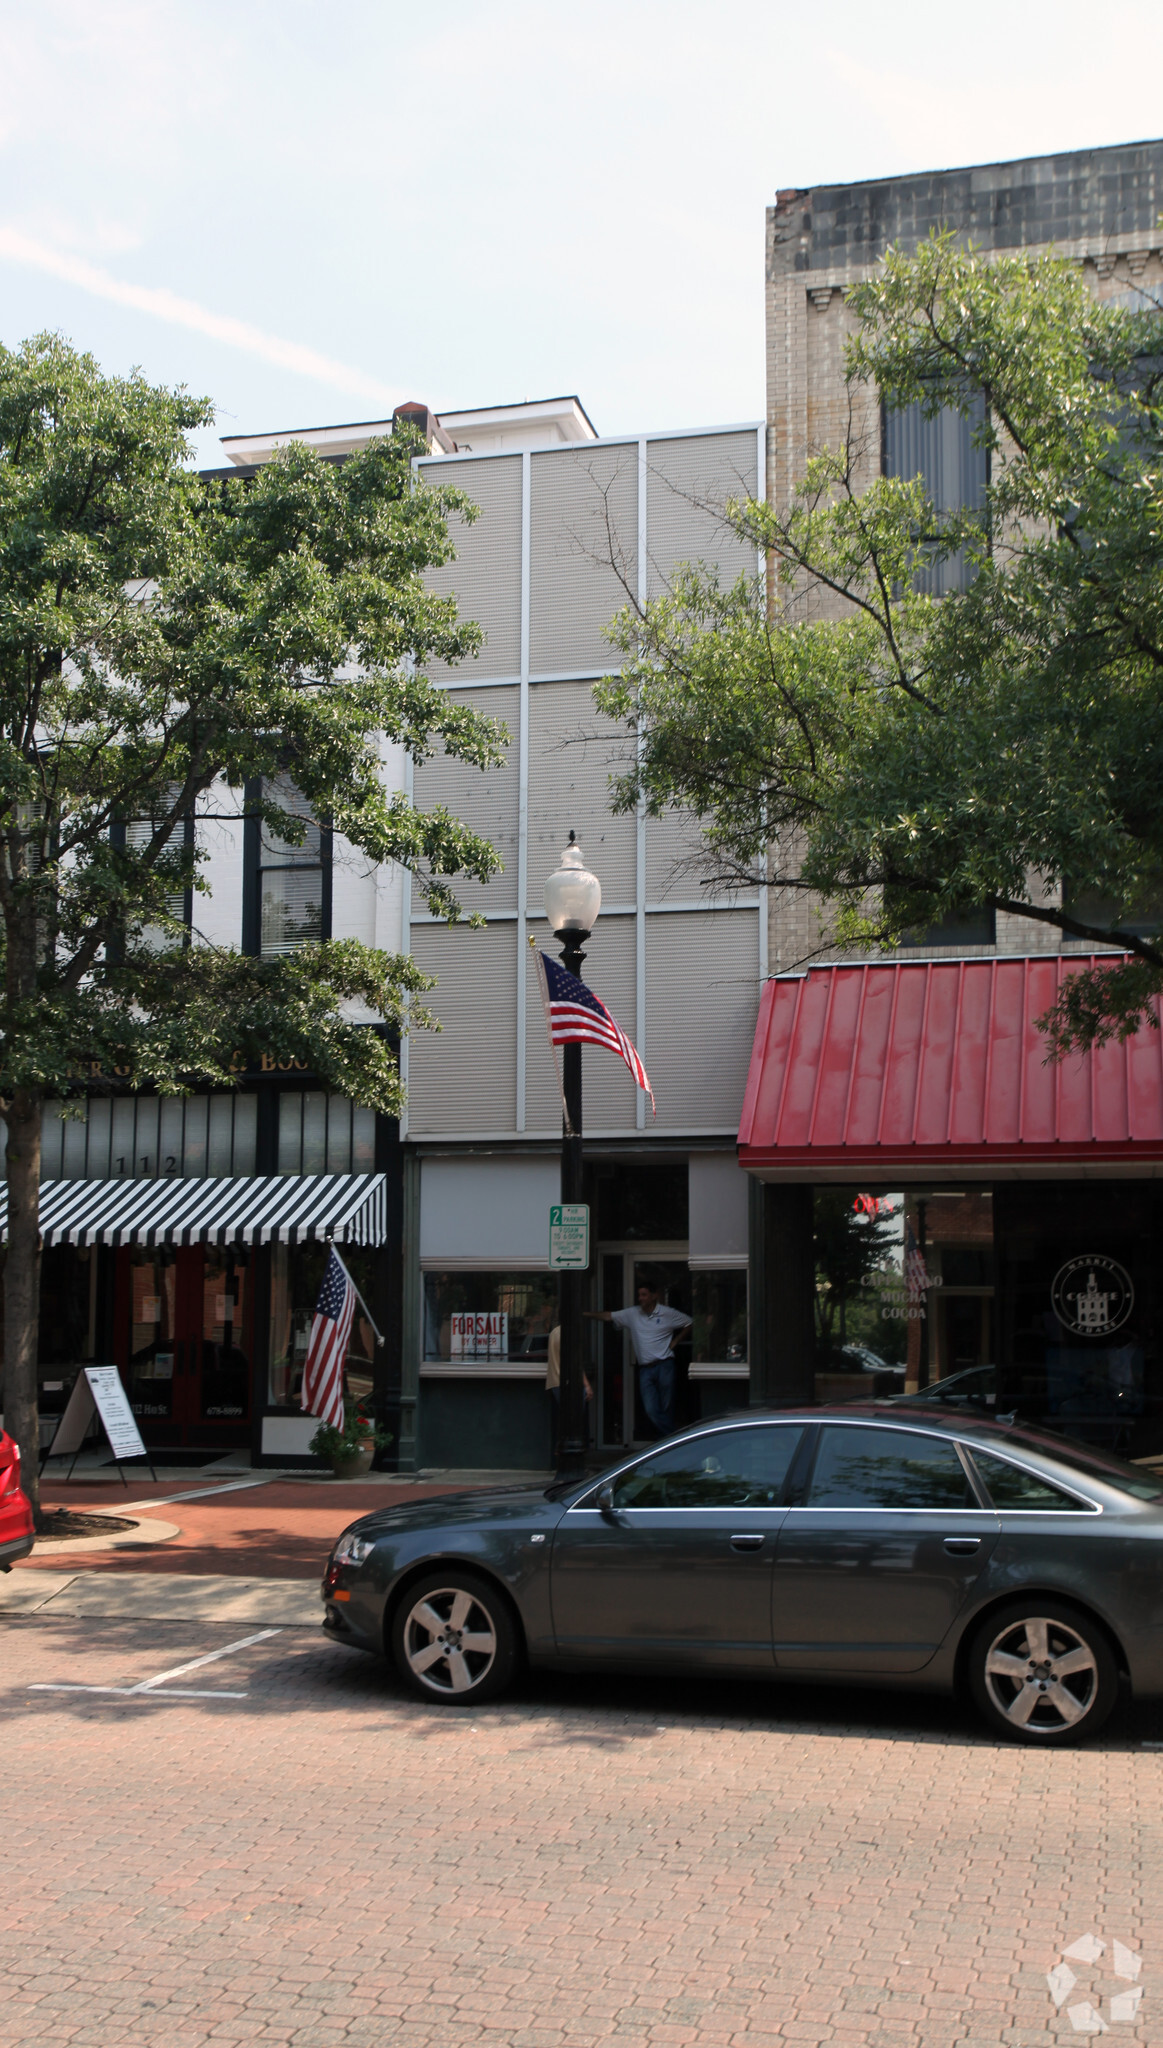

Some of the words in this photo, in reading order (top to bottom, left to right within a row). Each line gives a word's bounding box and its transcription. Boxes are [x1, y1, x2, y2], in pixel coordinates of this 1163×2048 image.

[853, 1196, 895, 1214] OPEN
[553, 1209, 560, 1224] 2
[880, 1291, 927, 1303] MOCHA
[881, 1307, 926, 1320] COCOA
[452, 1317, 474, 1335] FOR
[476, 1316, 505, 1335] SALE
[472, 1337, 497, 1346] OWNER
